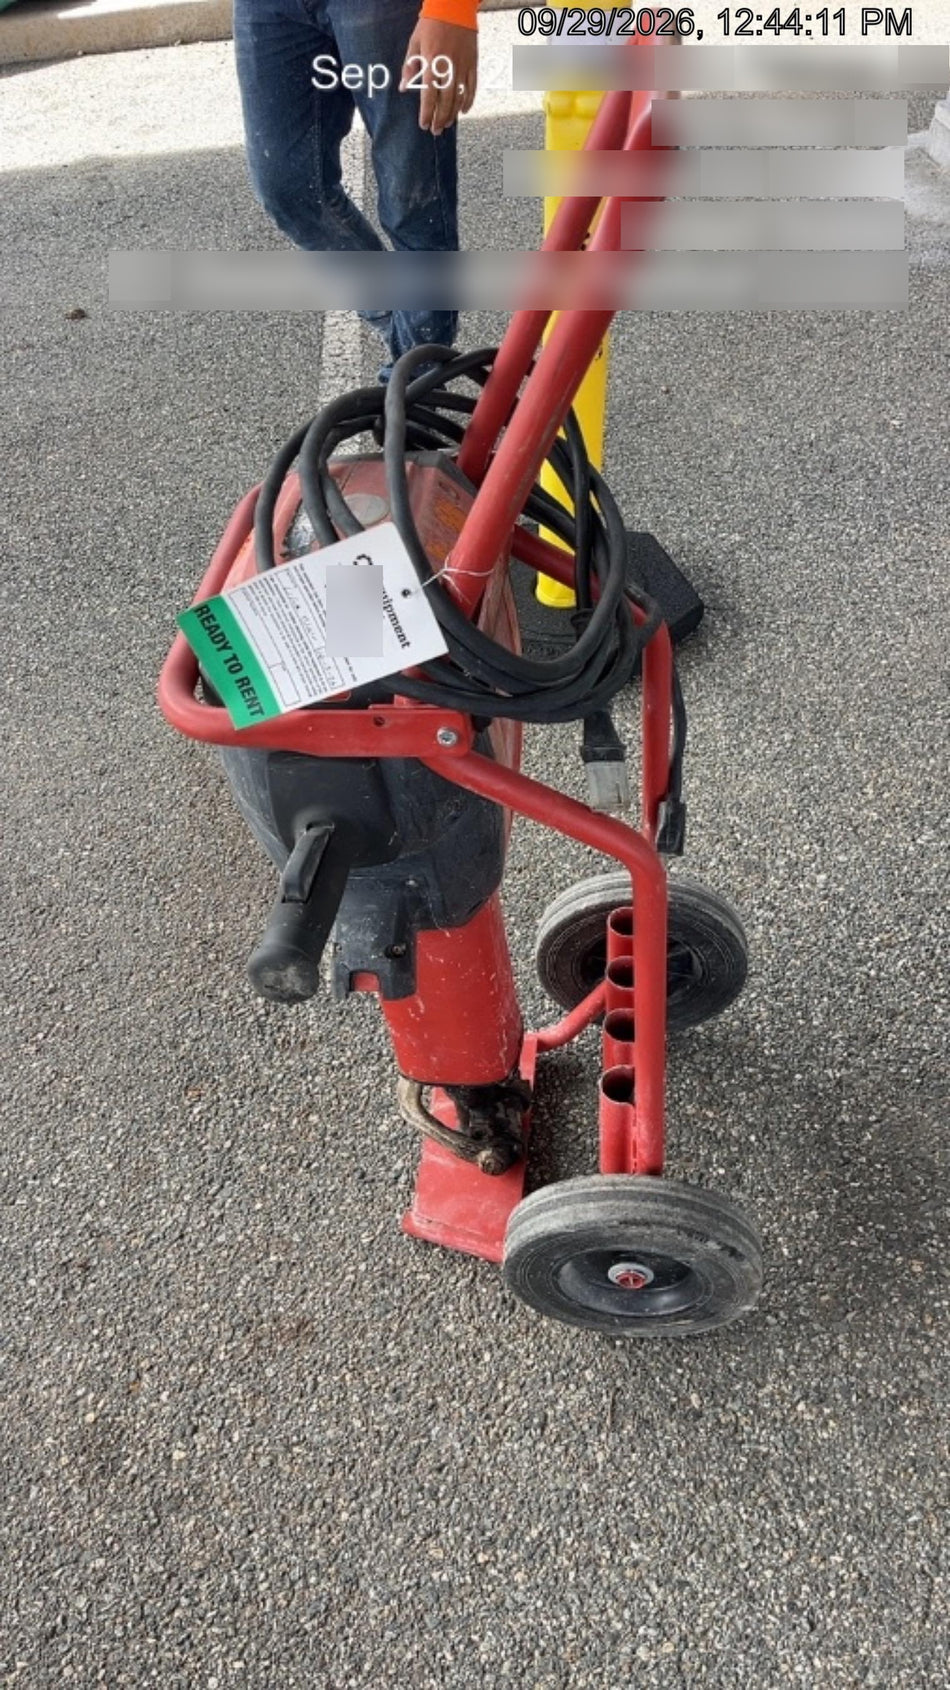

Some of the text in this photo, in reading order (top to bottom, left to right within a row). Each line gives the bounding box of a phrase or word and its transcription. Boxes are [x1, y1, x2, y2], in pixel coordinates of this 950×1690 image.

[194, 604, 264, 716] READY TO RENT
